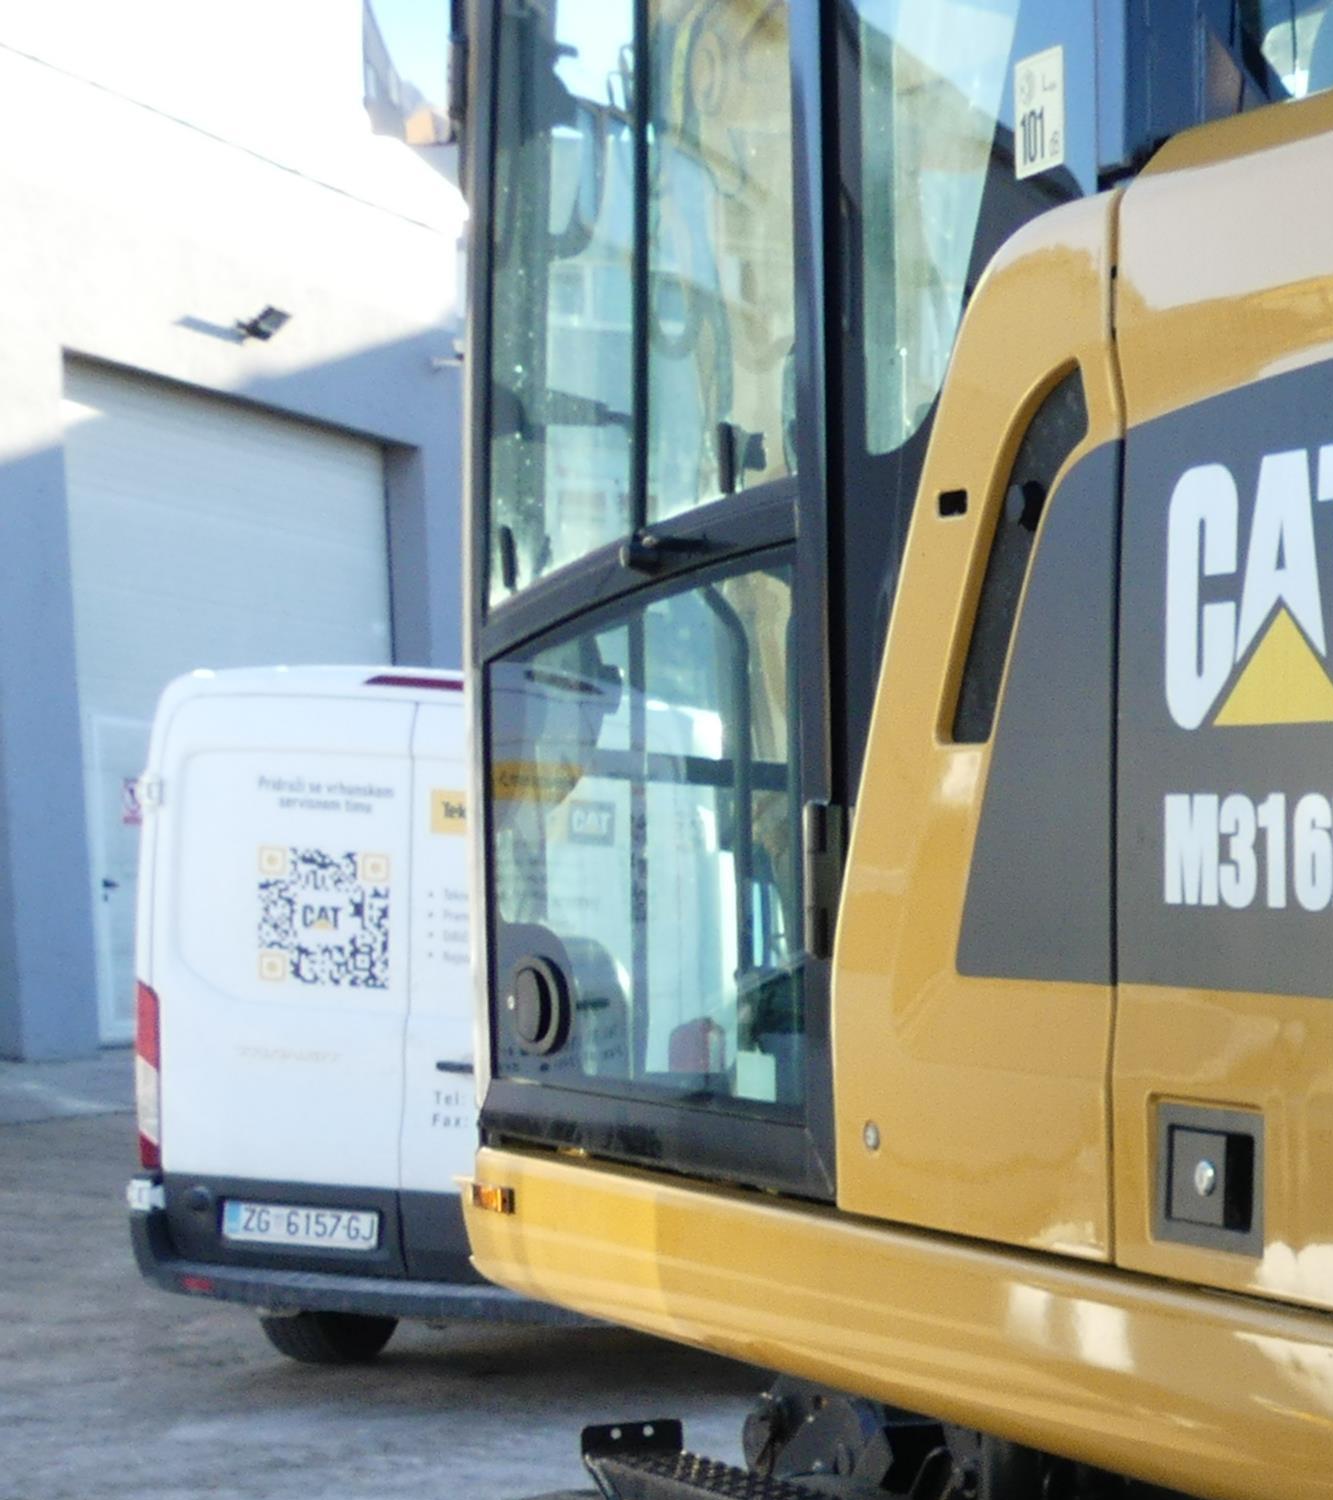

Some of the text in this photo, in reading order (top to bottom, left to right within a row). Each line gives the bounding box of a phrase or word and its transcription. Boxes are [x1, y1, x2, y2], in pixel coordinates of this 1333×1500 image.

[1020, 106, 1045, 165] 101
[302, 904, 342, 930] CAT
[243, 1206, 271, 1234] ZG
